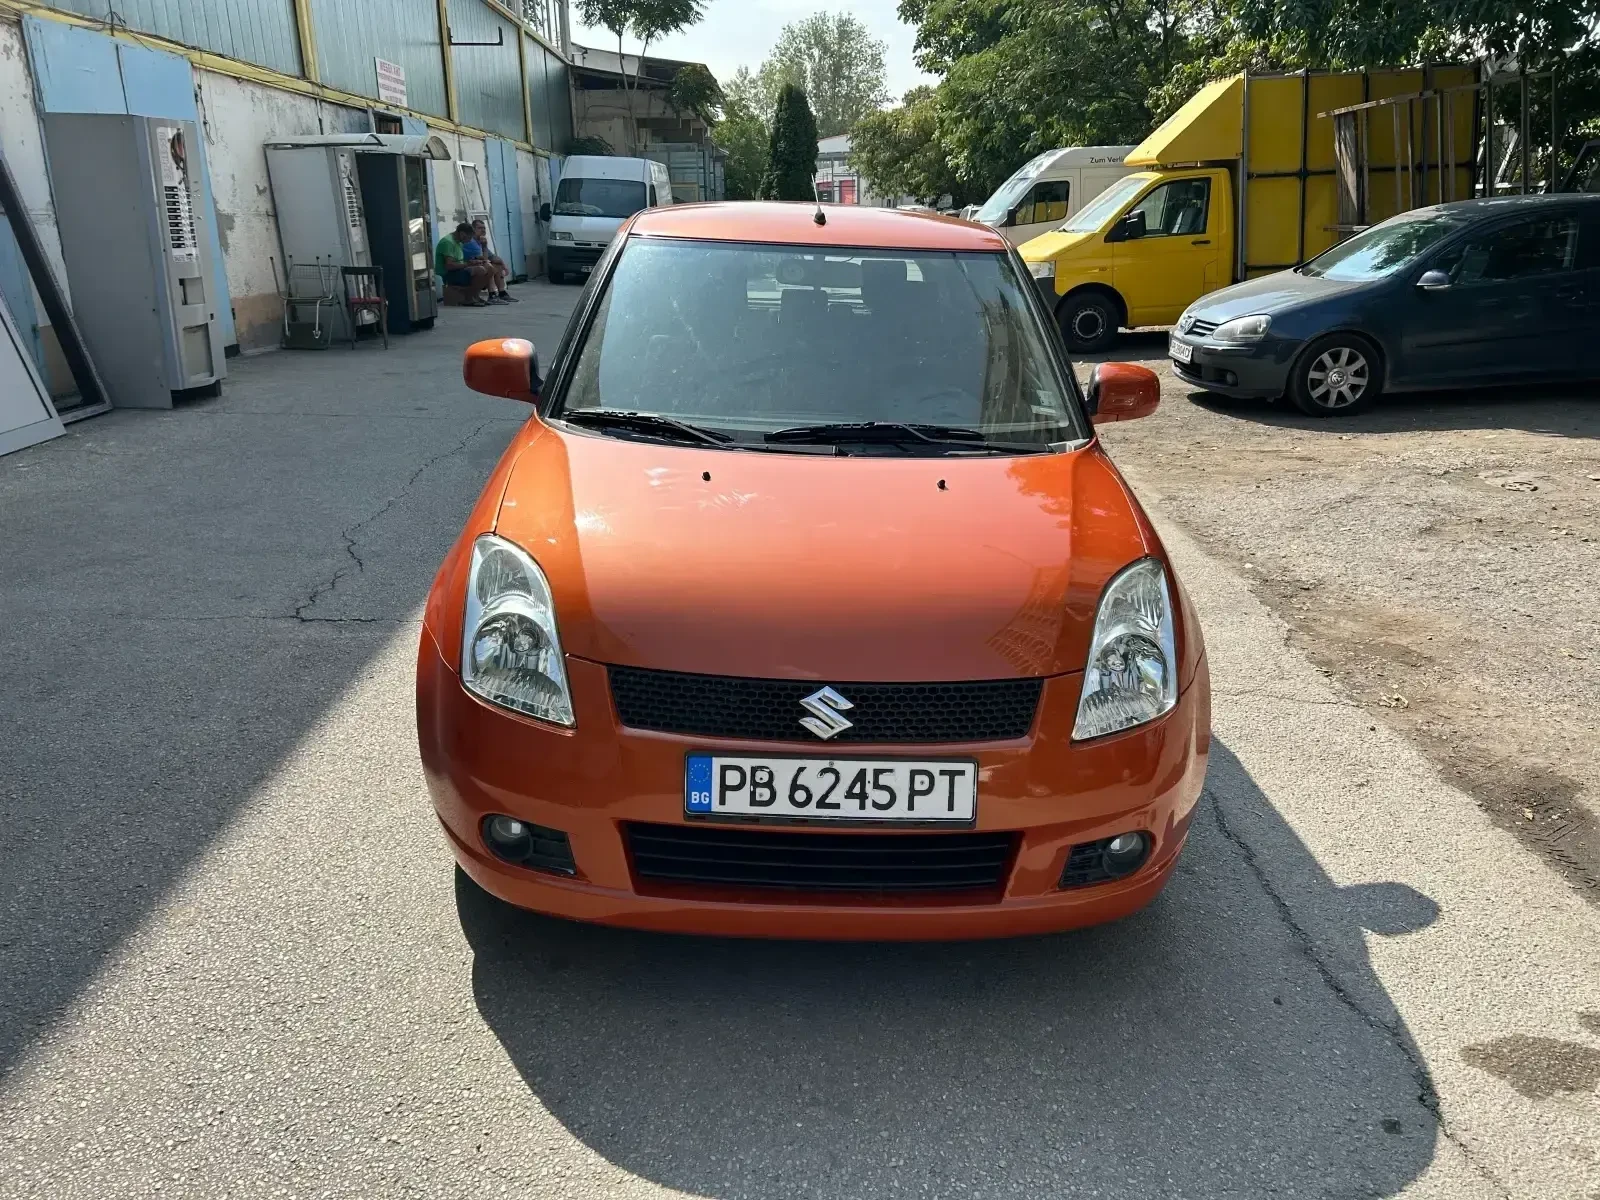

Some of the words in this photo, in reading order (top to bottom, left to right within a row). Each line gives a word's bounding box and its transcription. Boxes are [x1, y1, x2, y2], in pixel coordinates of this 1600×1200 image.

[691, 792, 710, 804] BG
[718, 764, 777, 808] PB
[788, 766, 897, 811] 6245
[907, 769, 966, 812] PT
